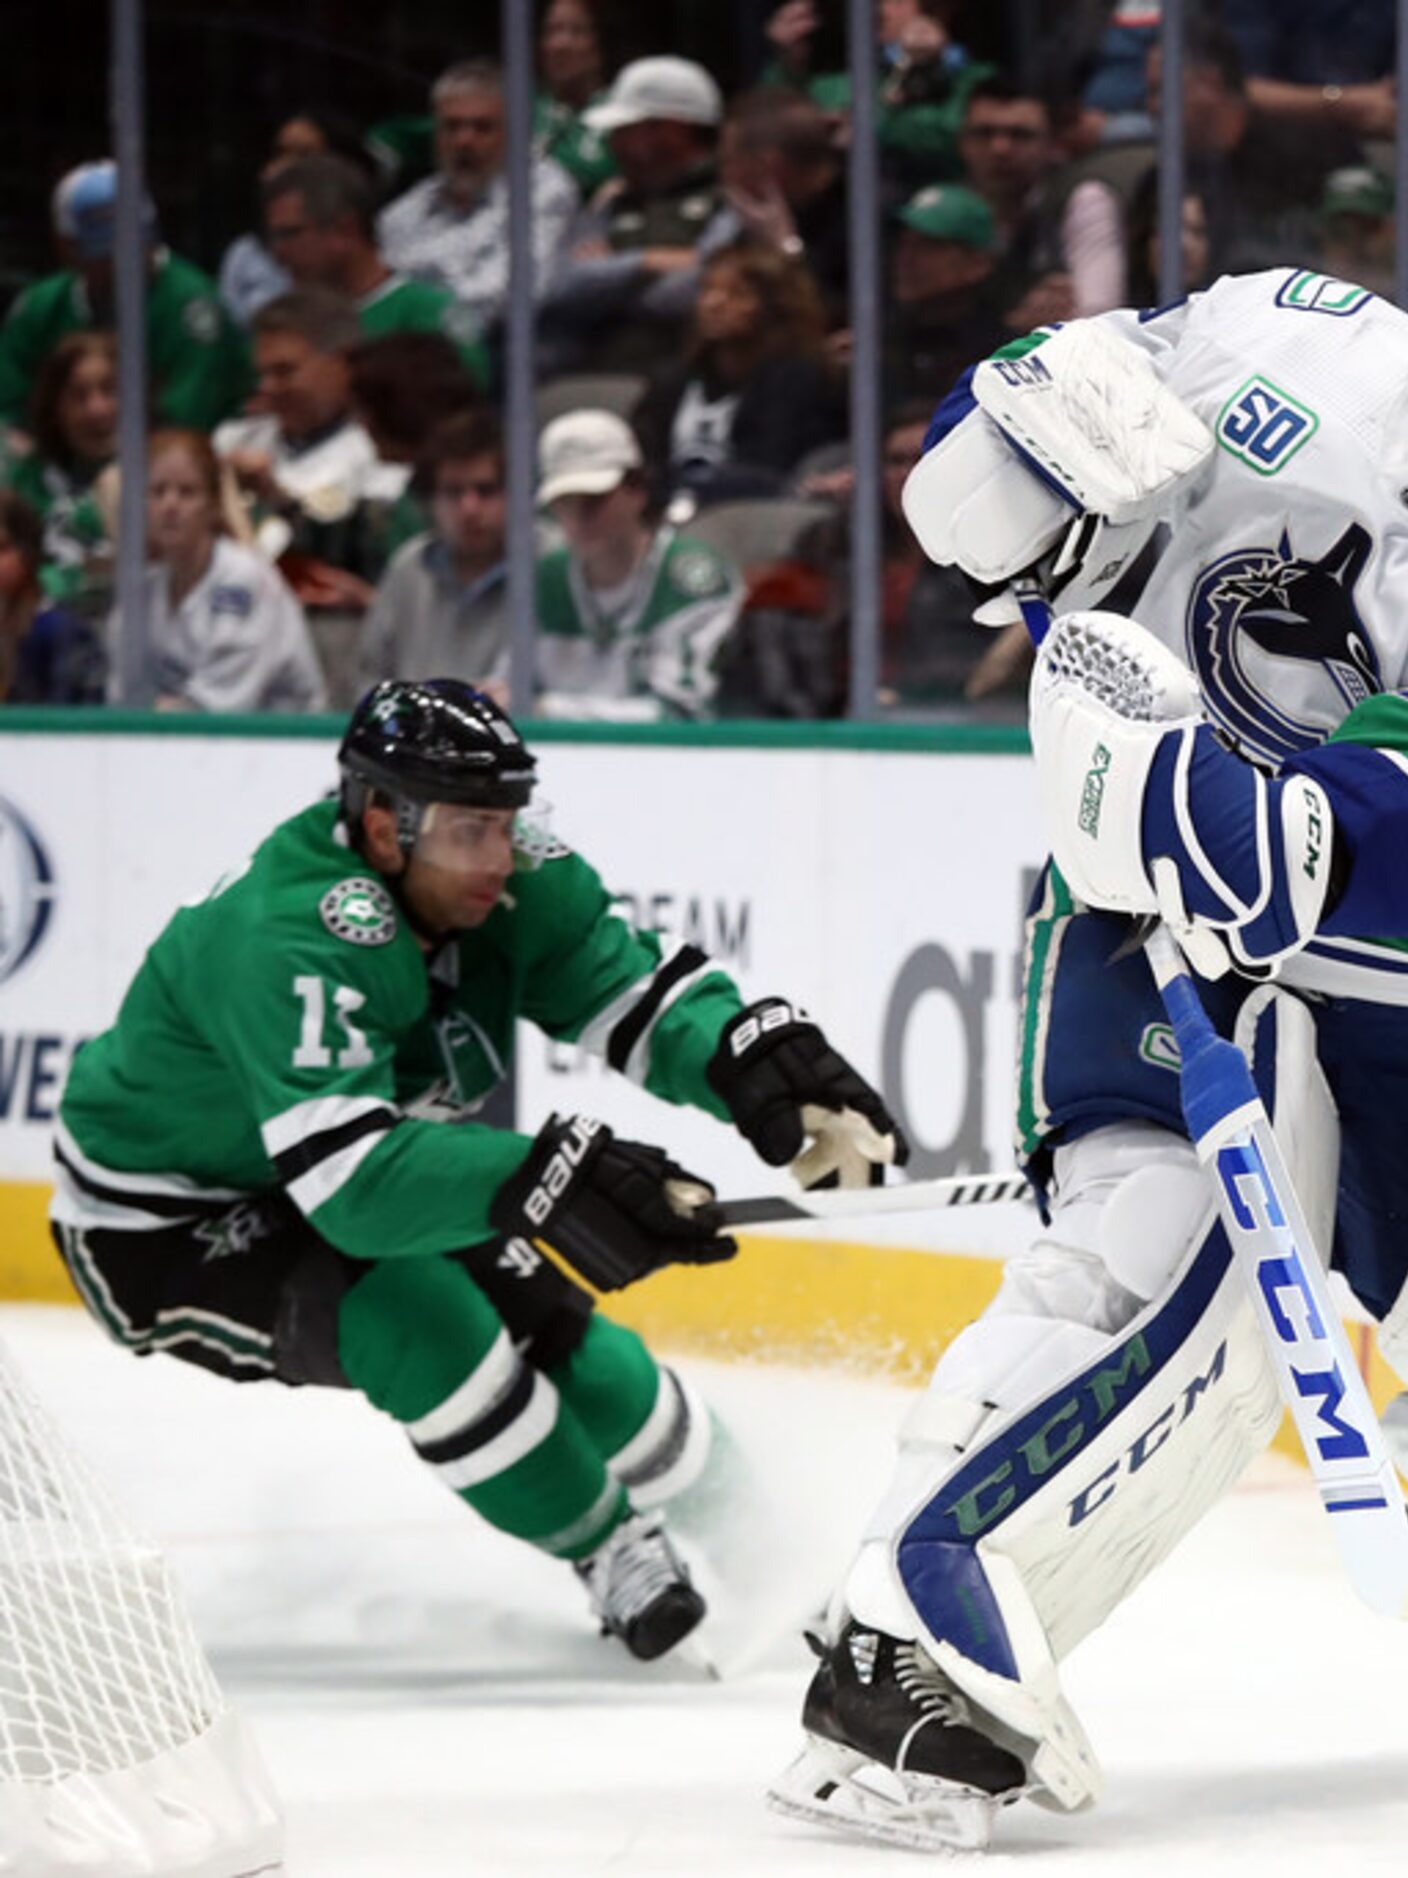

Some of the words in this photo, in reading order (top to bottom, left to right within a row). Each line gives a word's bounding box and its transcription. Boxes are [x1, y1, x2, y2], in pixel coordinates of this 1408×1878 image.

[1222, 387, 1308, 465] 50
[1217, 1134, 1370, 1462] CCM
[943, 1330, 1153, 1537] CCM
[1066, 1338, 1229, 1528] CCM
